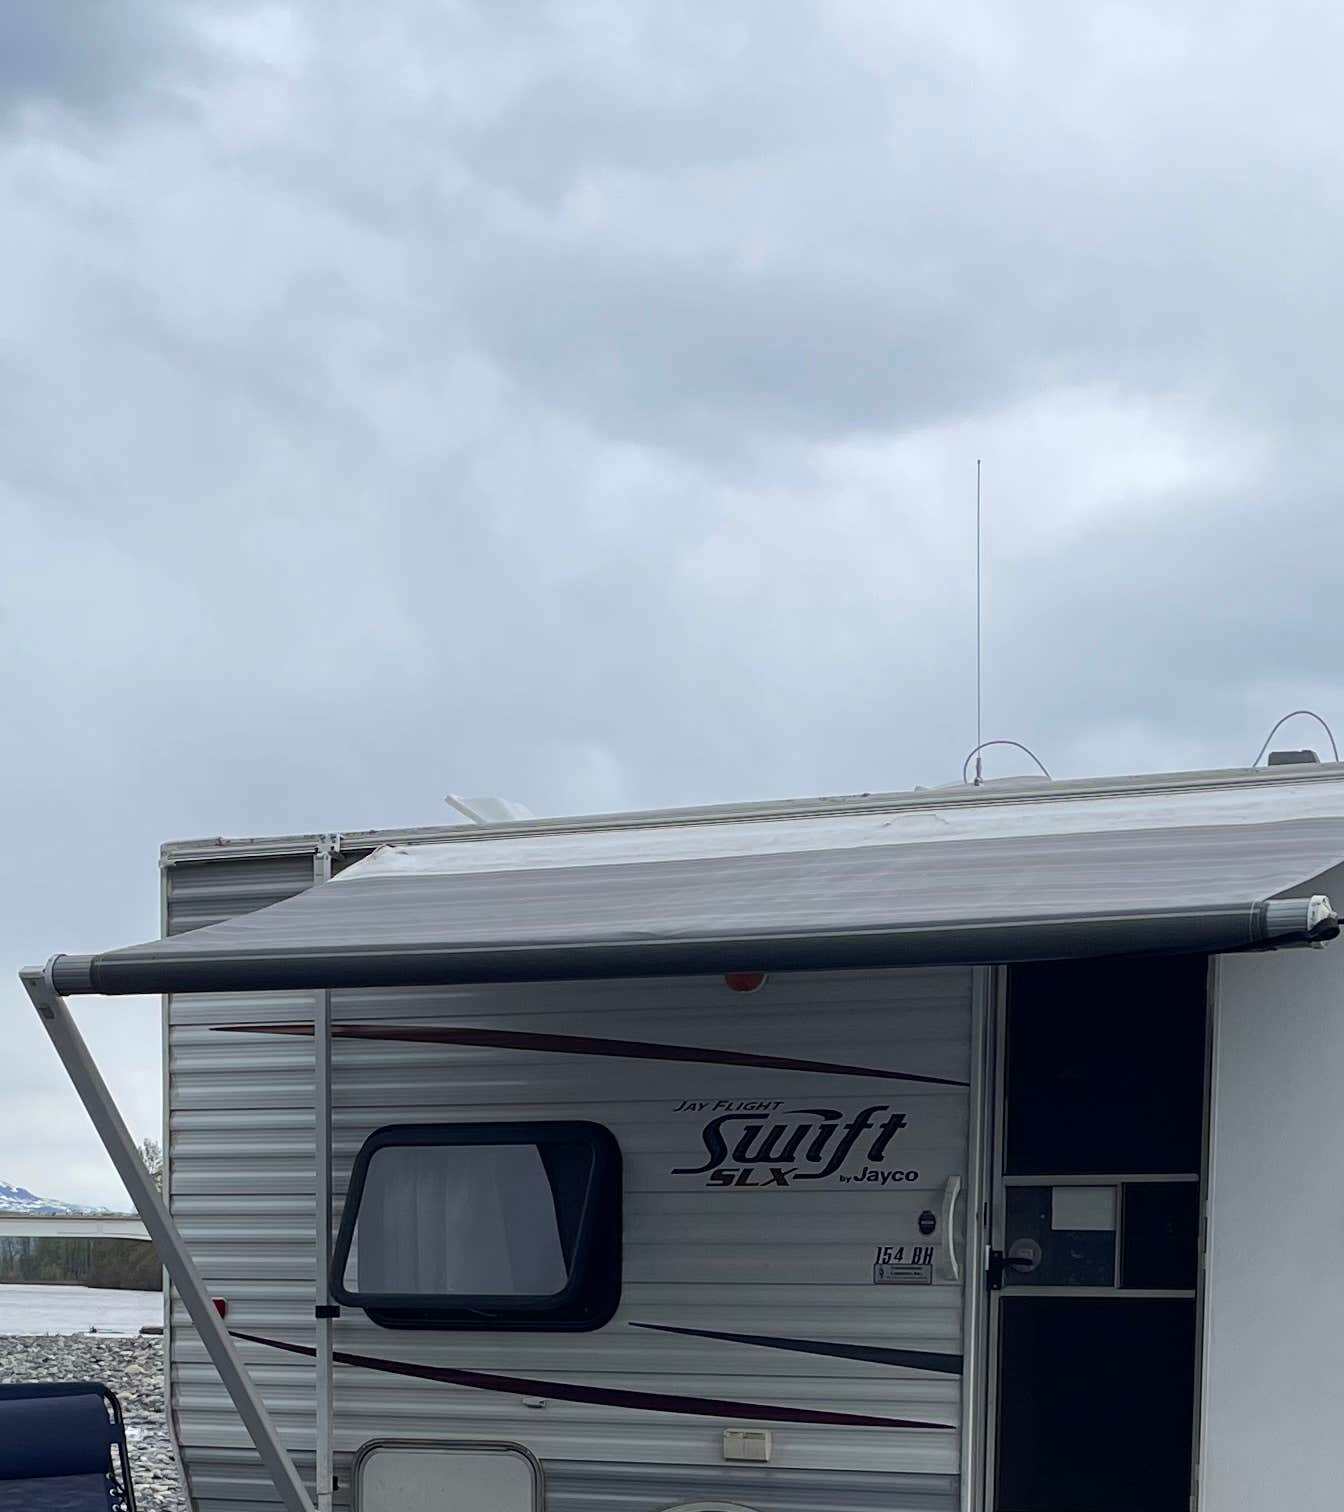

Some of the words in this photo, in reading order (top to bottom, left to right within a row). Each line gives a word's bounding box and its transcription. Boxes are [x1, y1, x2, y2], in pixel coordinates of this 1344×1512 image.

[674, 1100, 708, 1112] JAY
[713, 1100, 784, 1112] FLIGHT
[671, 1105, 907, 1179] Swift
[706, 1167, 798, 1186] SLX
[839, 1173, 851, 1184] by
[854, 1166, 919, 1185] Jayco
[875, 1246, 904, 1264] 154
[911, 1246, 934, 1264] BH
